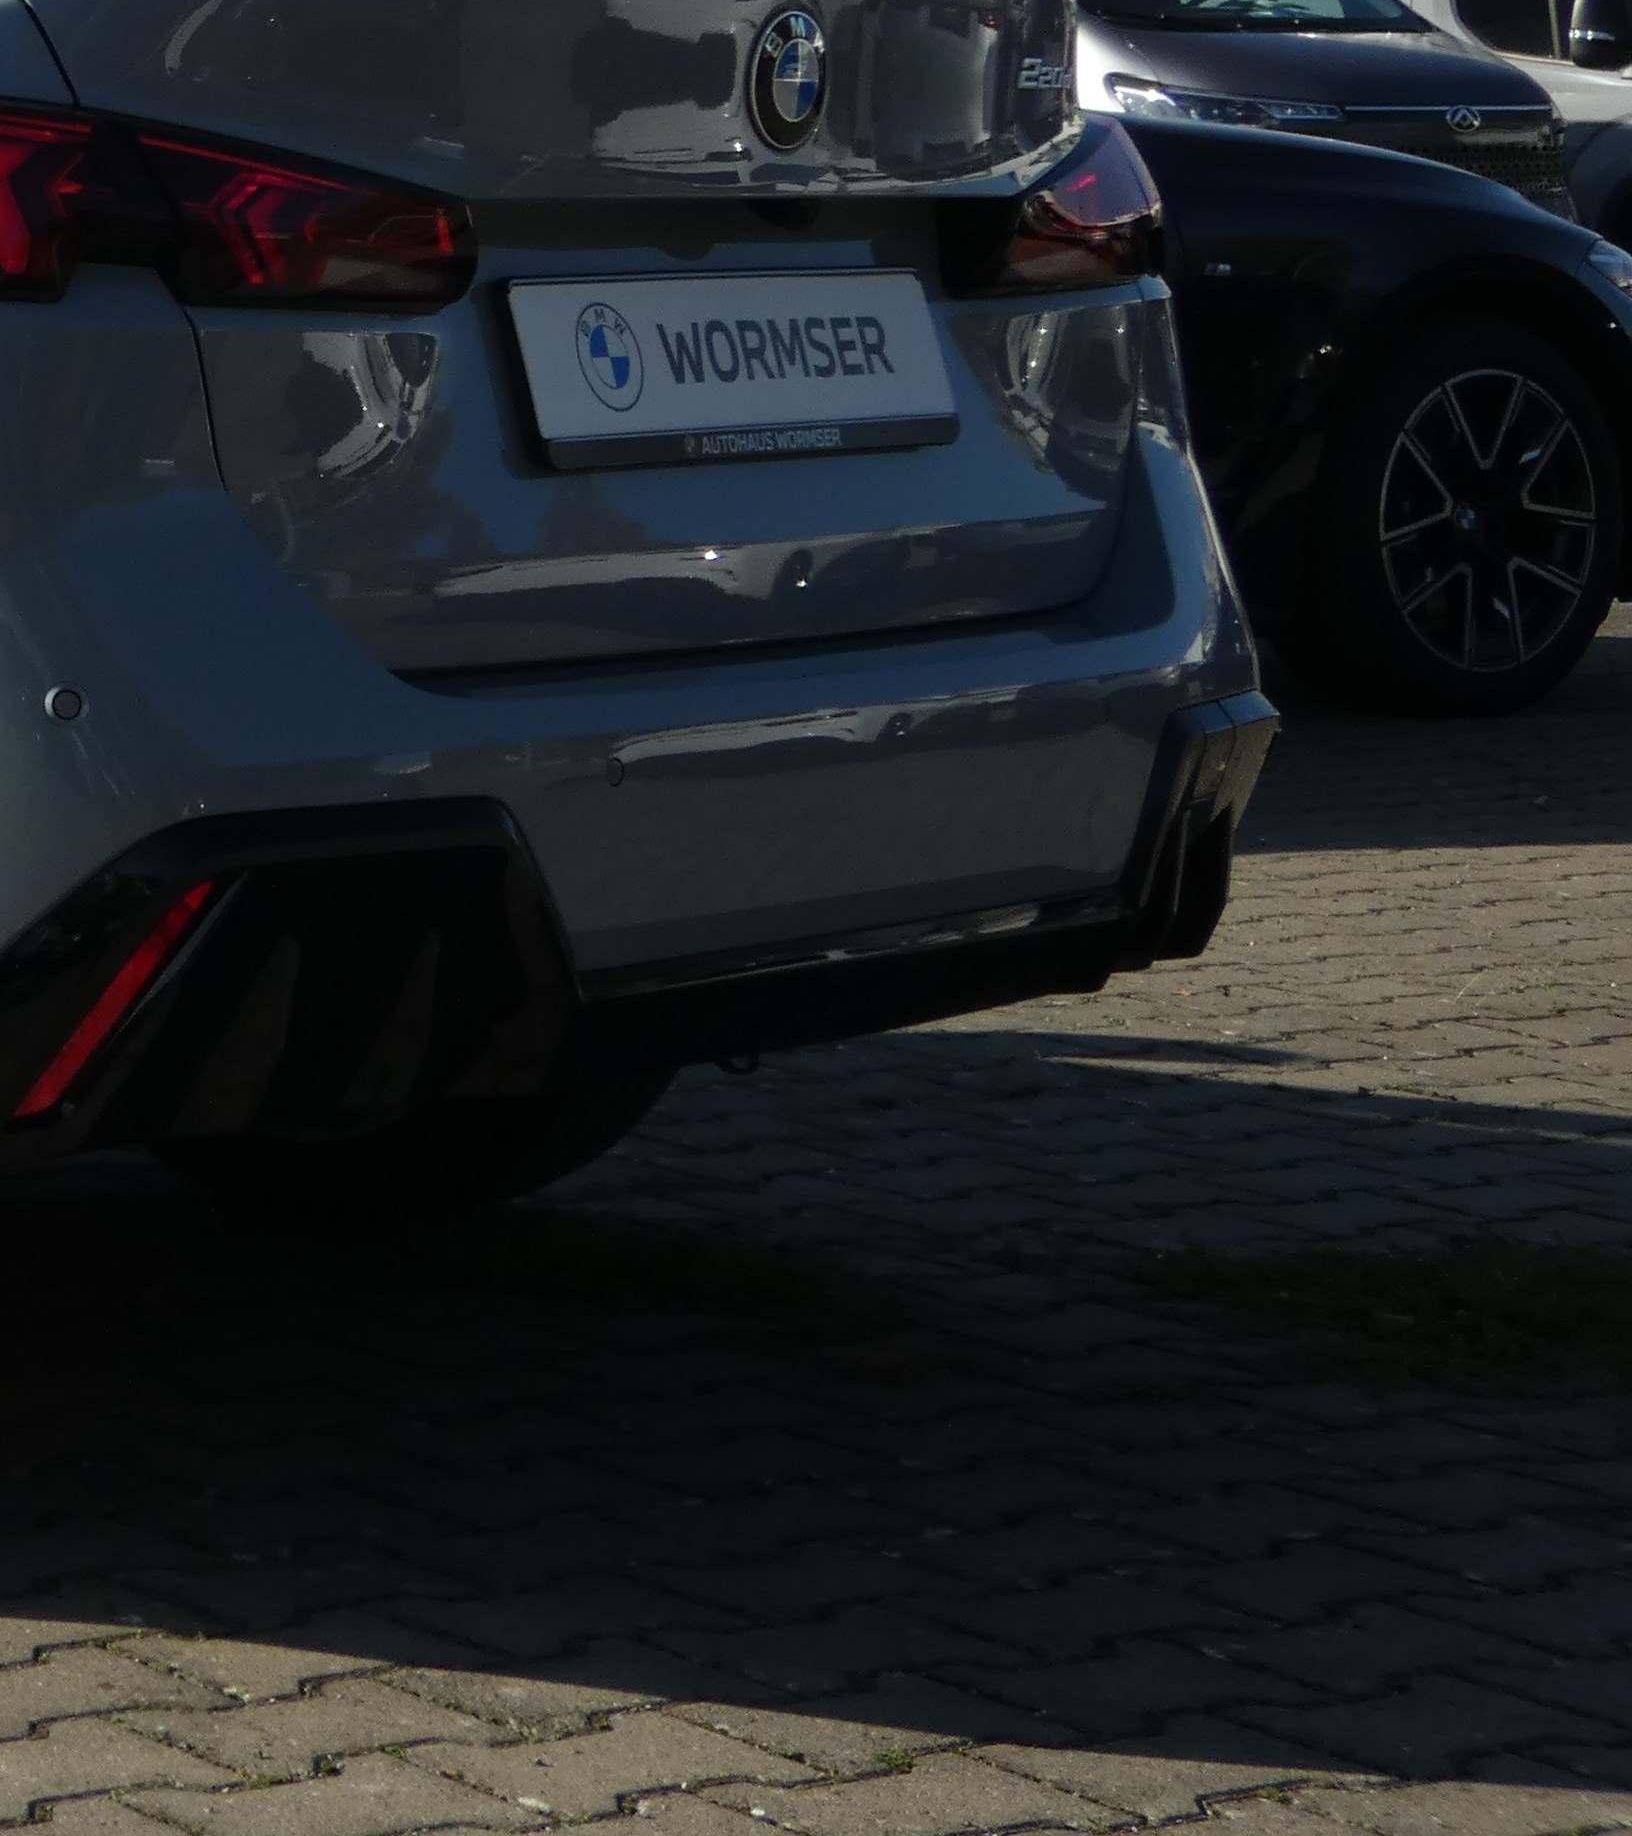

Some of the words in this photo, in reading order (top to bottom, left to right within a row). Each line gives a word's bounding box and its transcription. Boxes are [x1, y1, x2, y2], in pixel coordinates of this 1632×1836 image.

[580, 307, 627, 338] BMW
[655, 316, 895, 385] WORMSER
[701, 431, 774, 455] AUTOHAUS
[774, 428, 842, 451] WORMSER
